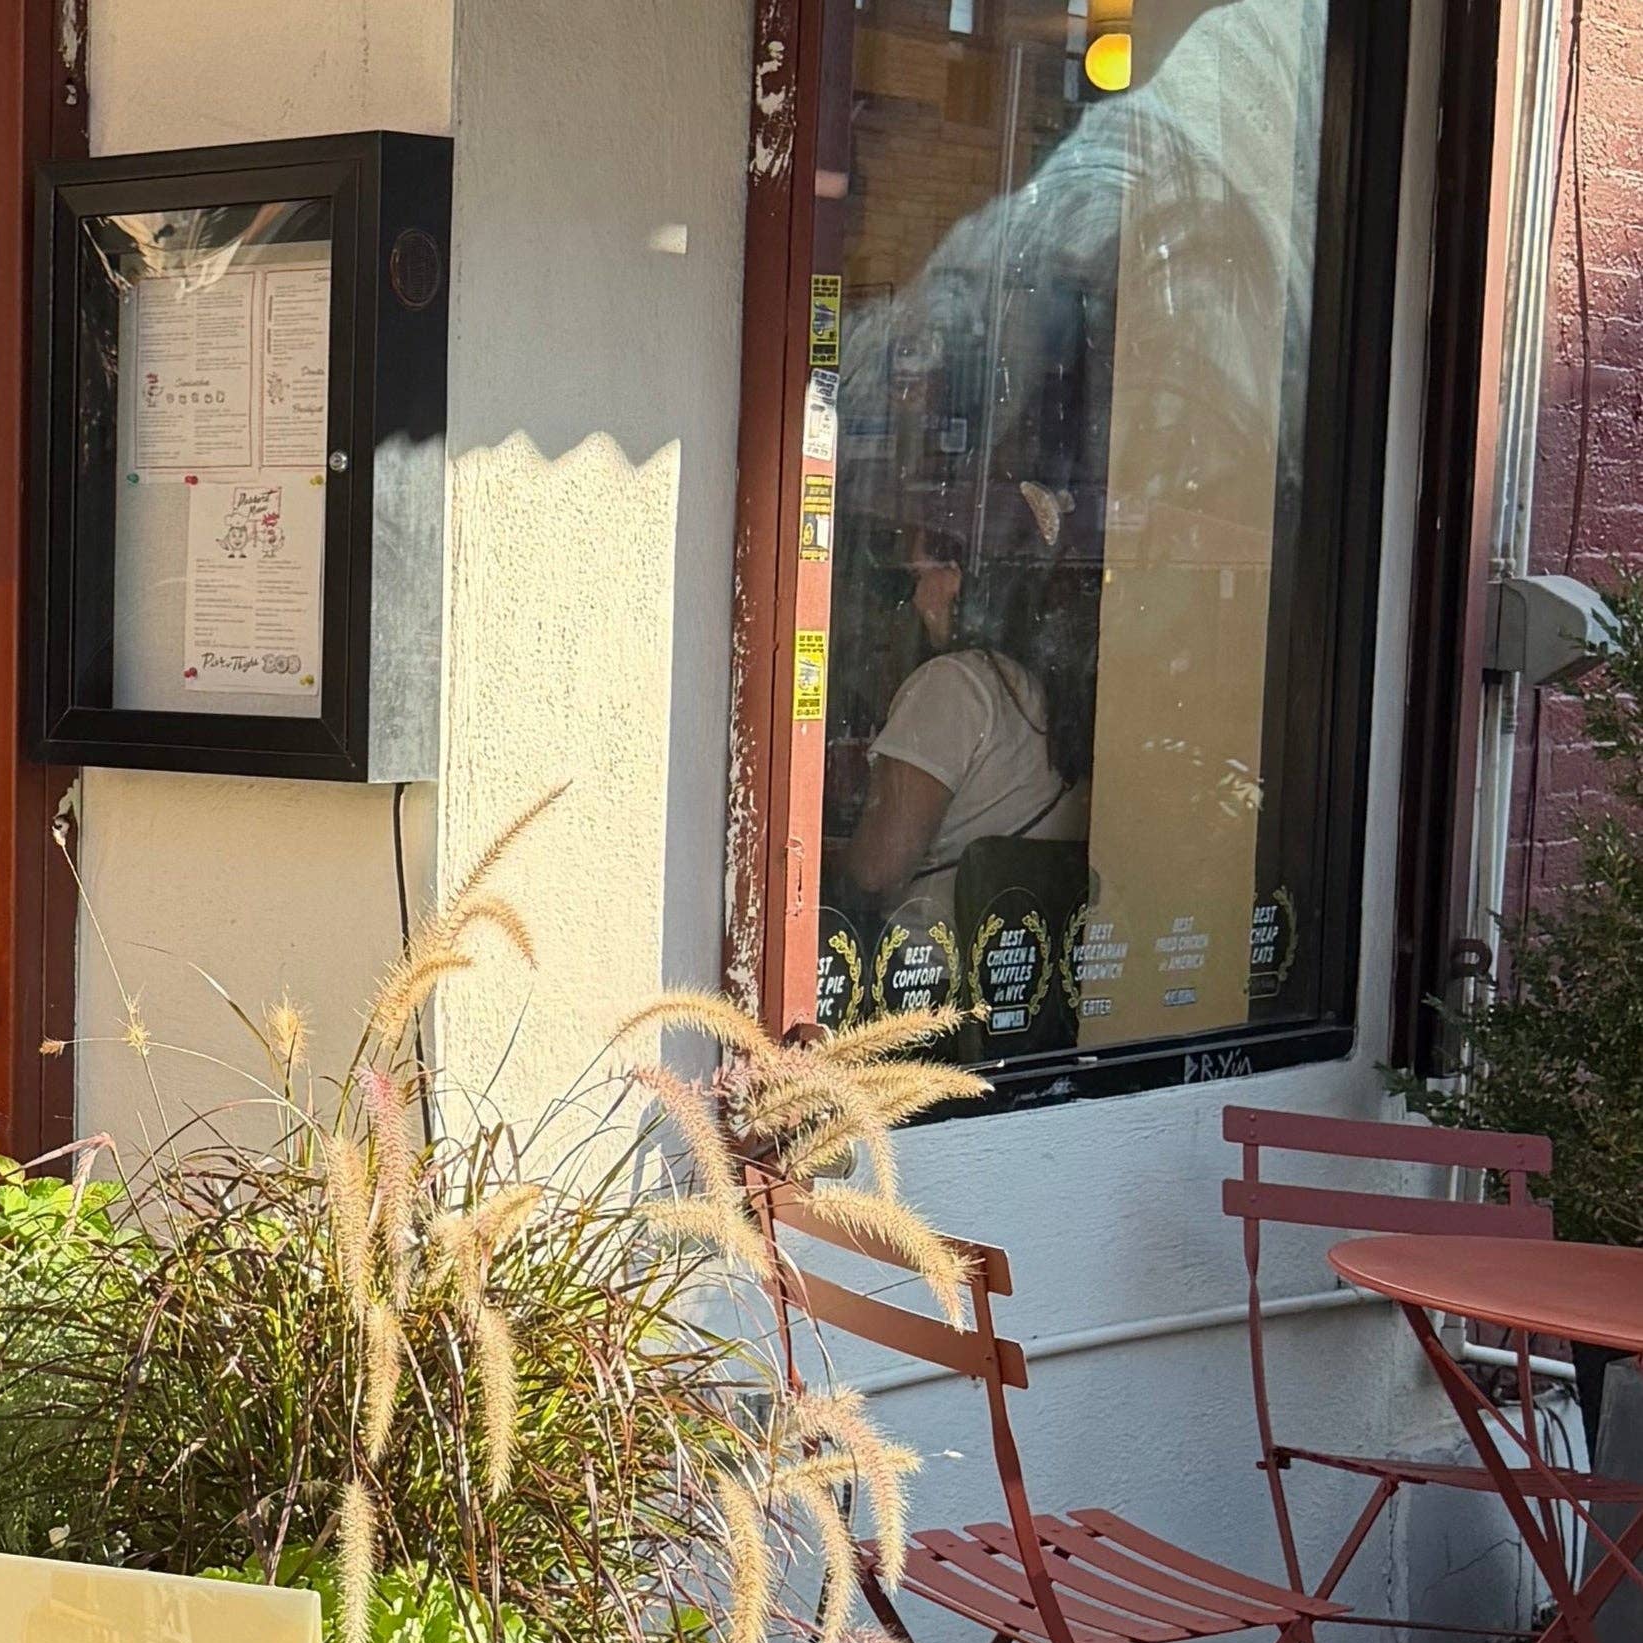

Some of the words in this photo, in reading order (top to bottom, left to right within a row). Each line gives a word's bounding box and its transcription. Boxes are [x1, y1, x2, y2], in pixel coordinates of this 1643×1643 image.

[1253, 905, 1278, 924] BEST
[999, 928, 1026, 947] BEST
[904, 945, 933, 965] BEST
[986, 947, 1028, 967] CHICKEN
[892, 965, 944, 989] COMFORT
[990, 964, 1033, 985] WAFFLES
[825, 976, 846, 995] PIE
[1005, 983, 1026, 1001] NYC
[901, 989, 932, 1009] FOOD
